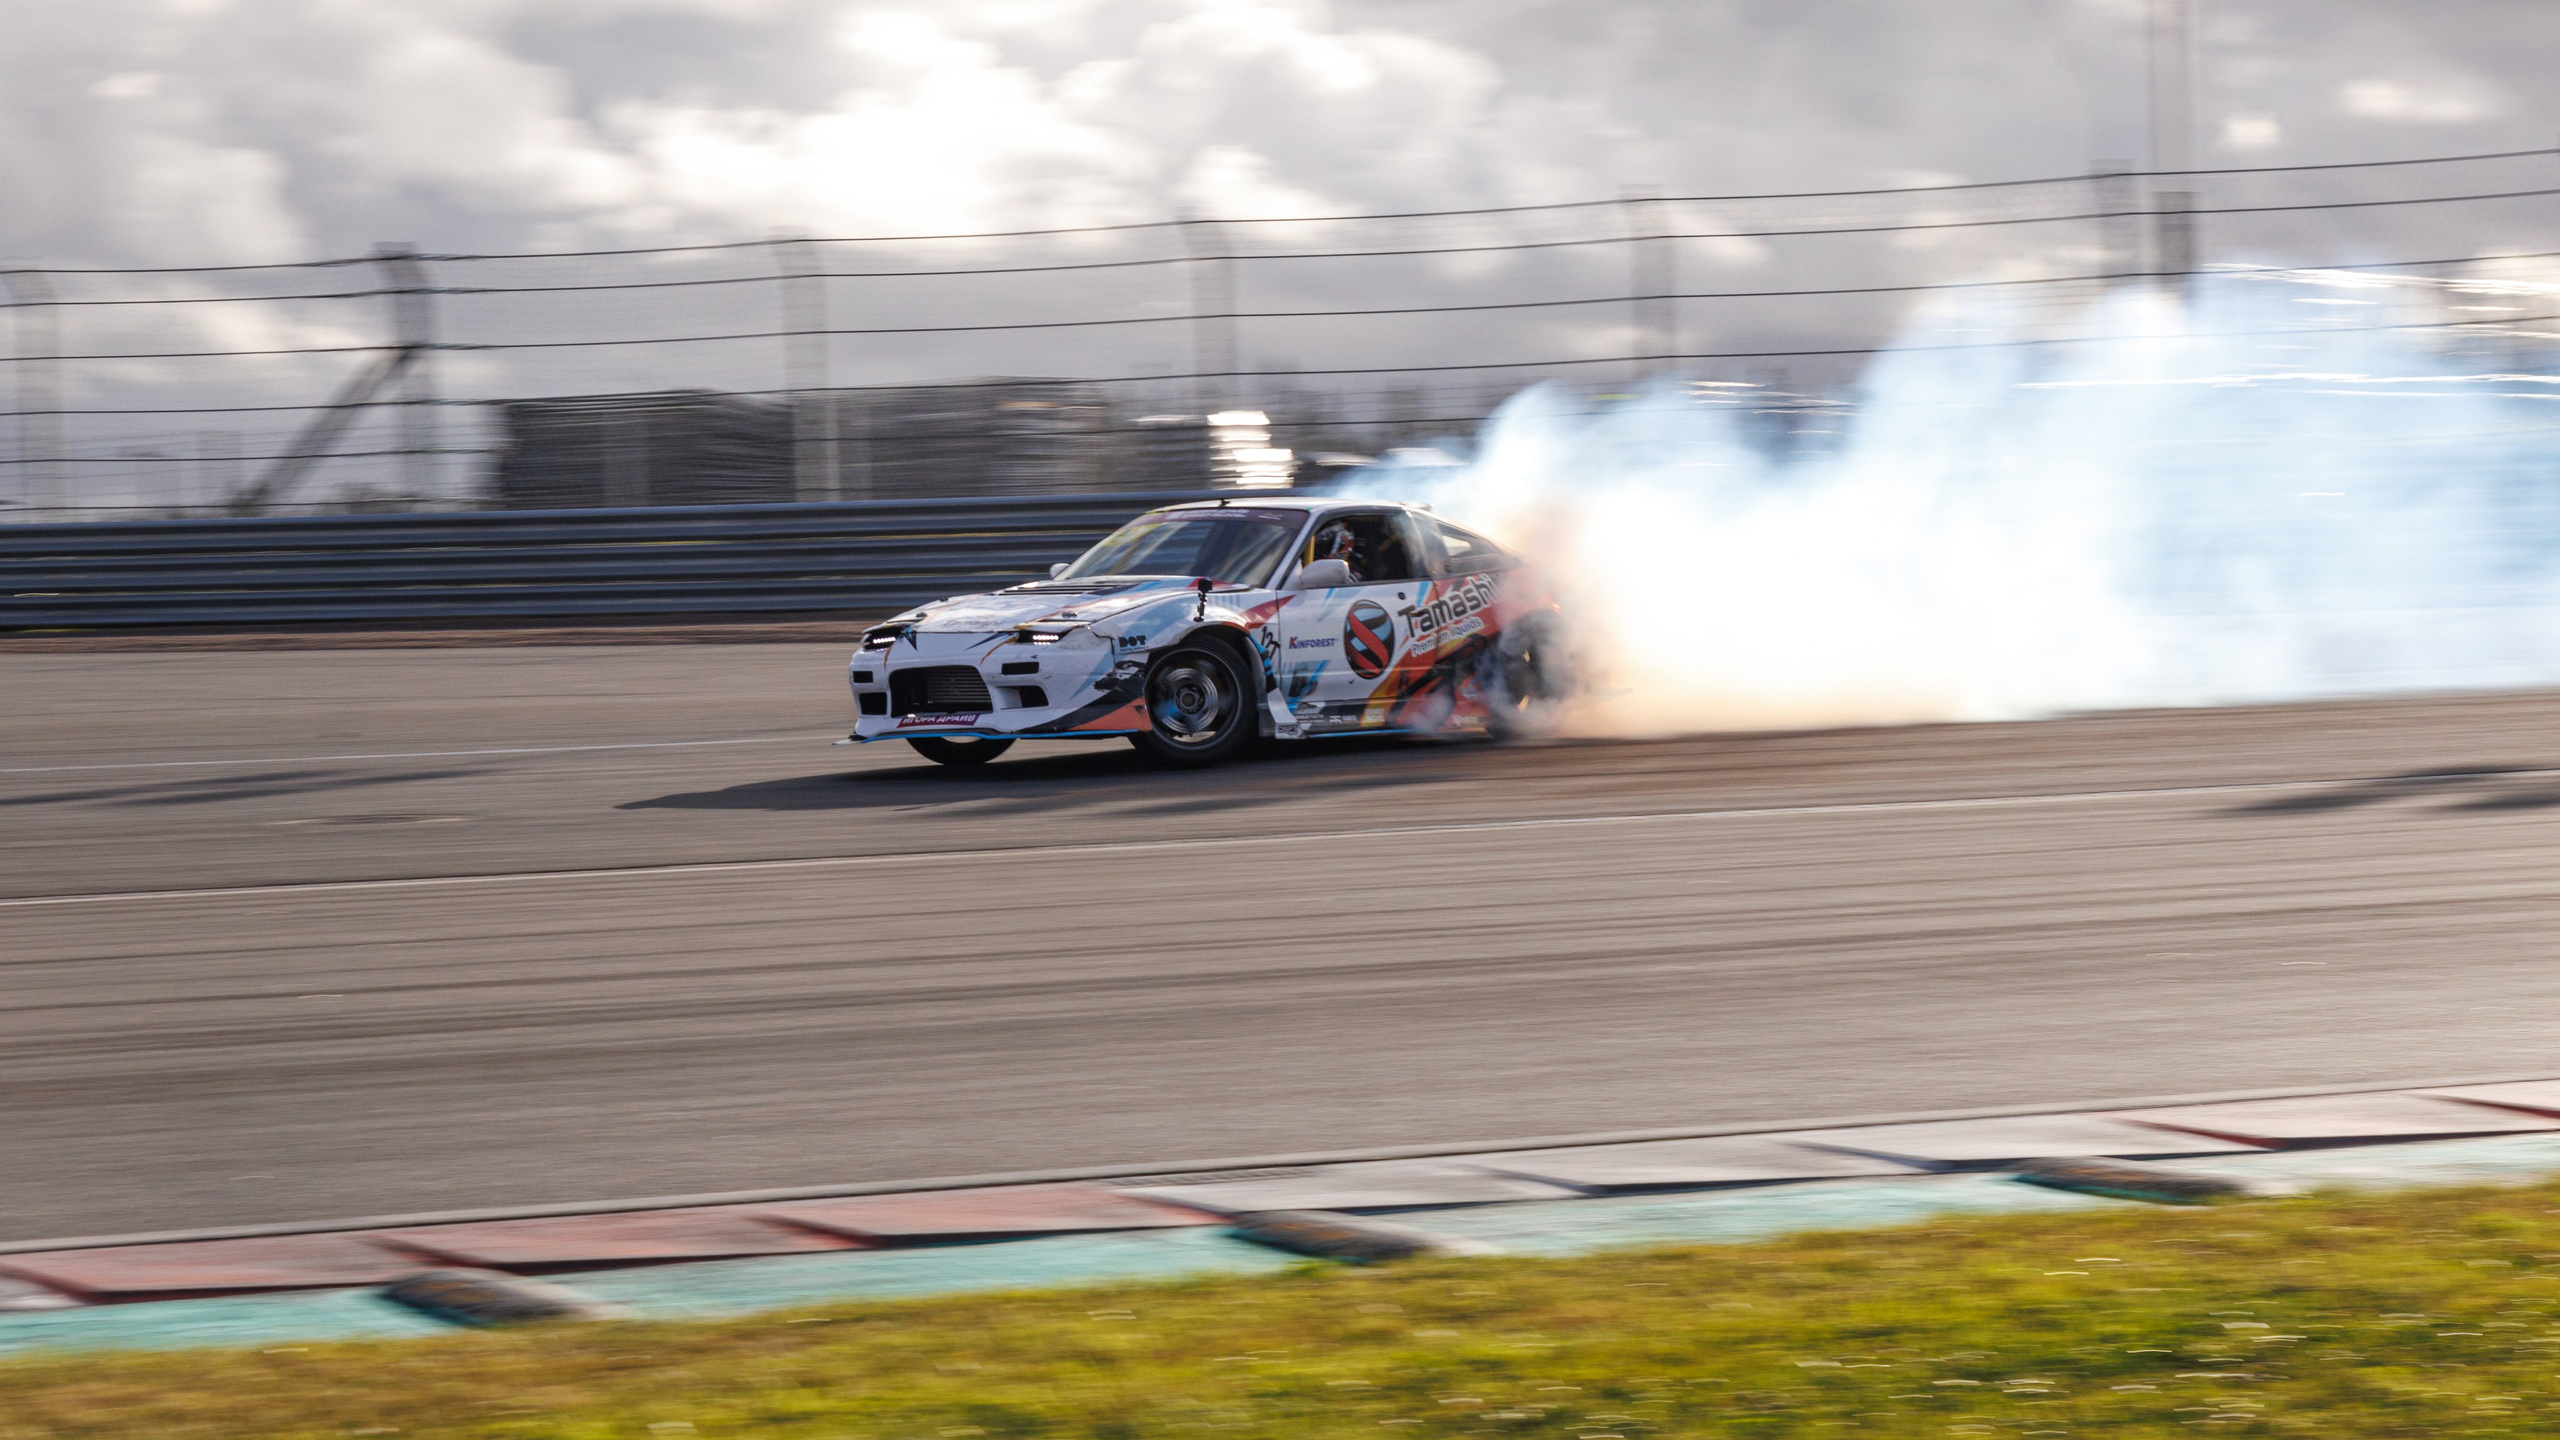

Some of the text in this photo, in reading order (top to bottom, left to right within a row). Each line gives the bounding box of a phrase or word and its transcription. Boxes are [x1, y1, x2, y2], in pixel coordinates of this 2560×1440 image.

[1397, 573, 1497, 638] Tamashi
[1119, 635, 1146, 647] DOT
[1289, 636, 1335, 649] KINFOREST
